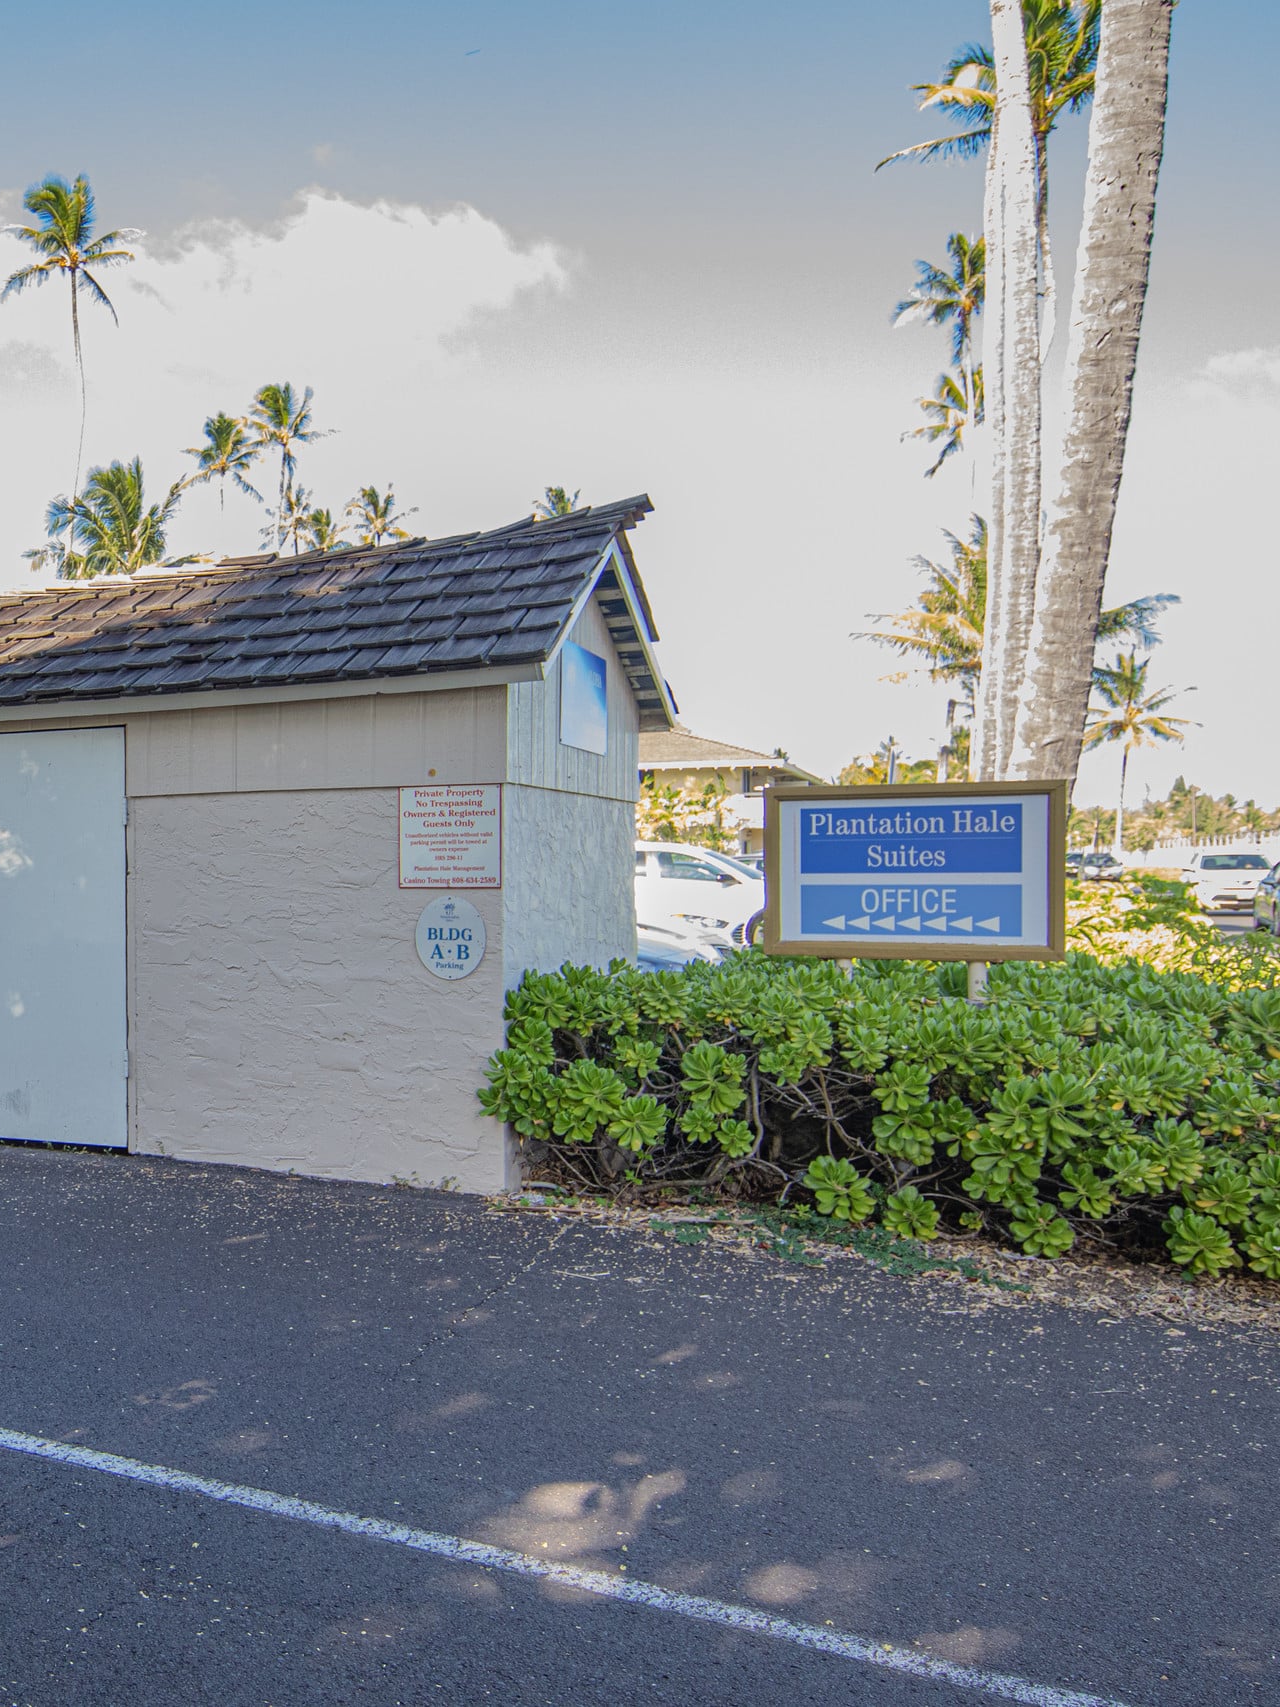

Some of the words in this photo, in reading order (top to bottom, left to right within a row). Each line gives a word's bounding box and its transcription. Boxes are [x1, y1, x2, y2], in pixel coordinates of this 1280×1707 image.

[414, 790, 444, 798] Private
[446, 788, 485, 798] Property
[416, 800, 428, 808] No
[430, 799, 483, 808] Trespassing
[403, 810, 436, 818] Owners
[448, 809, 496, 818] Registered
[423, 820, 452, 828] Guests
[454, 820, 476, 828] Only
[809, 812, 945, 836] Plantation
[951, 809, 1016, 834] Hale
[867, 844, 946, 868] Suites
[427, 877, 450, 885] Towing
[861, 888, 957, 914] OFFICE
[427, 927, 473, 941] BLDG
[430, 944, 444, 960] A
[457, 944, 470, 960] B
[435, 962, 464, 970] Parking
